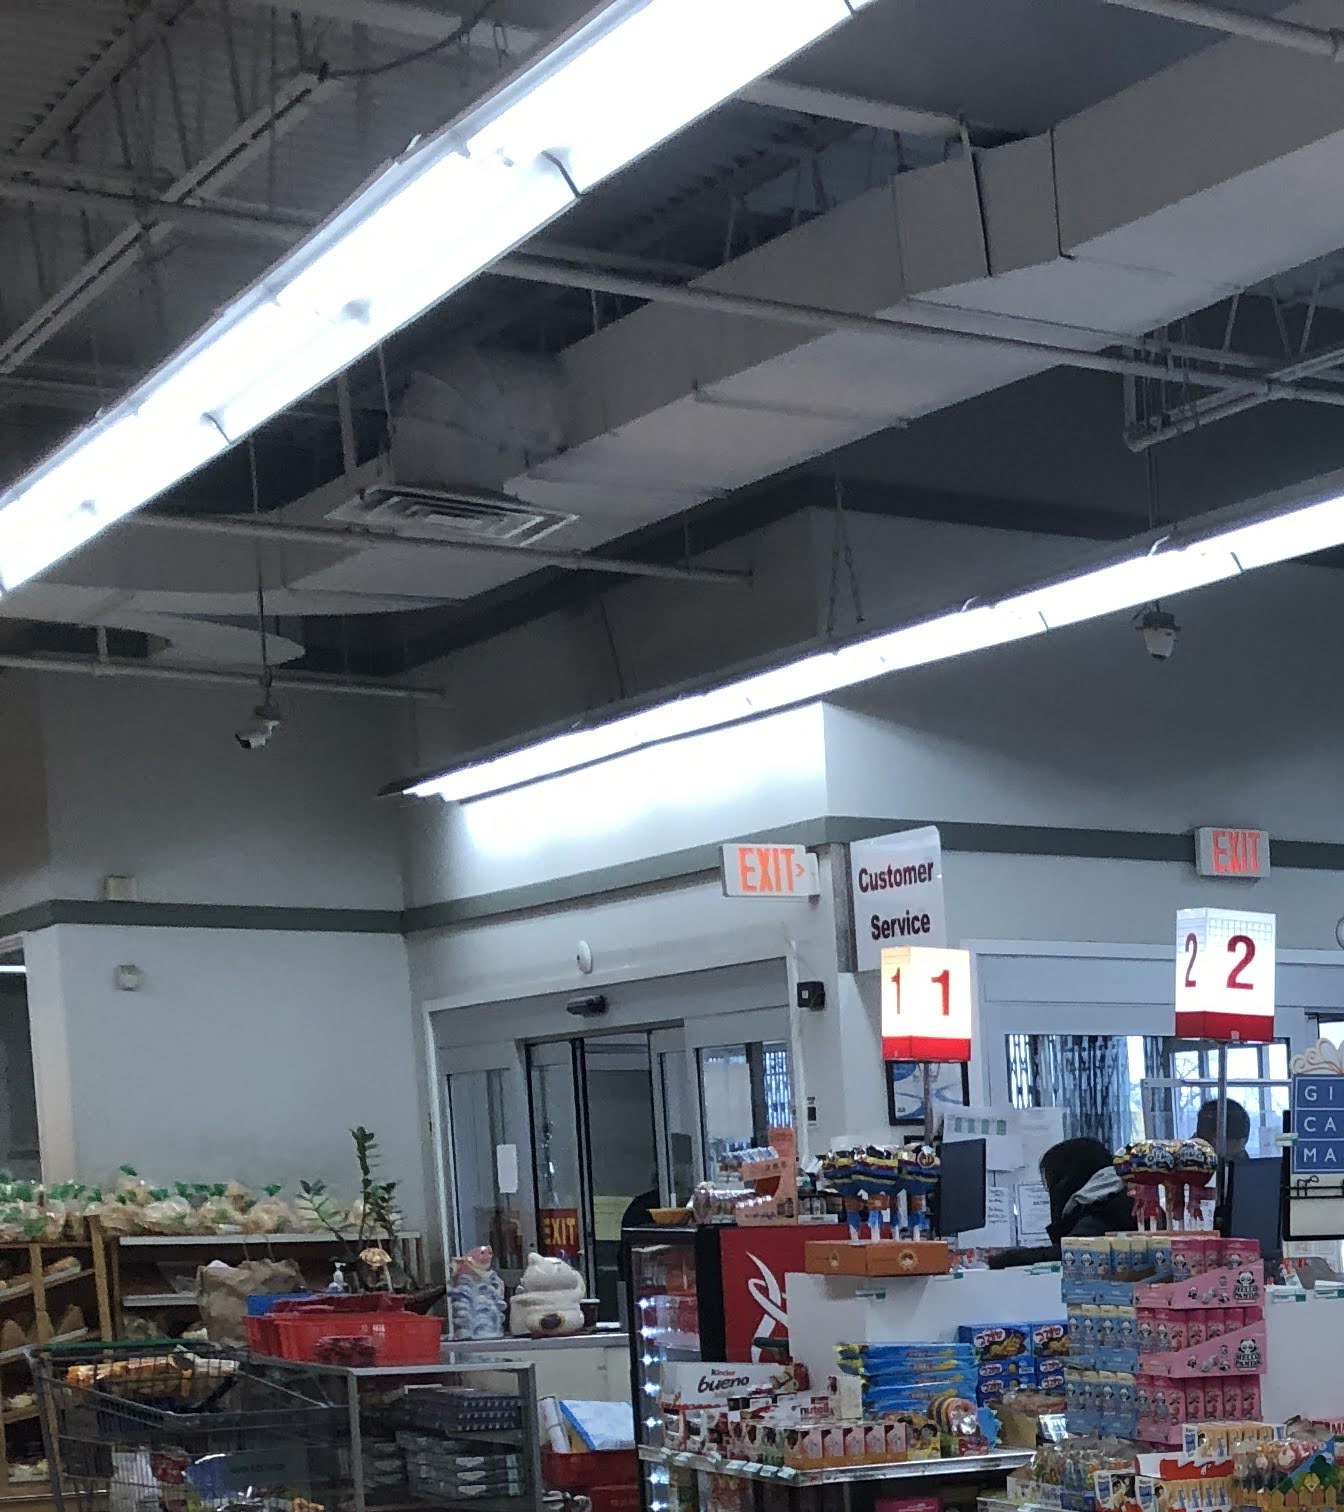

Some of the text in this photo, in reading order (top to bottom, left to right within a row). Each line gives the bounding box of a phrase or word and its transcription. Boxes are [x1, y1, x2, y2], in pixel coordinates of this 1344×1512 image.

[738, 848, 795, 893] EXIT
[1212, 830, 1261, 874] EXIT
[858, 859, 933, 894] Customer
[871, 913, 931, 941] Service
[1184, 932, 1197, 988] 2
[1226, 935, 1257, 990] 2
[890, 968, 901, 1014] 1
[932, 969, 949, 1015] 1
[544, 1218, 575, 1245] EXIT
[697, 1376, 749, 1393] bueno
